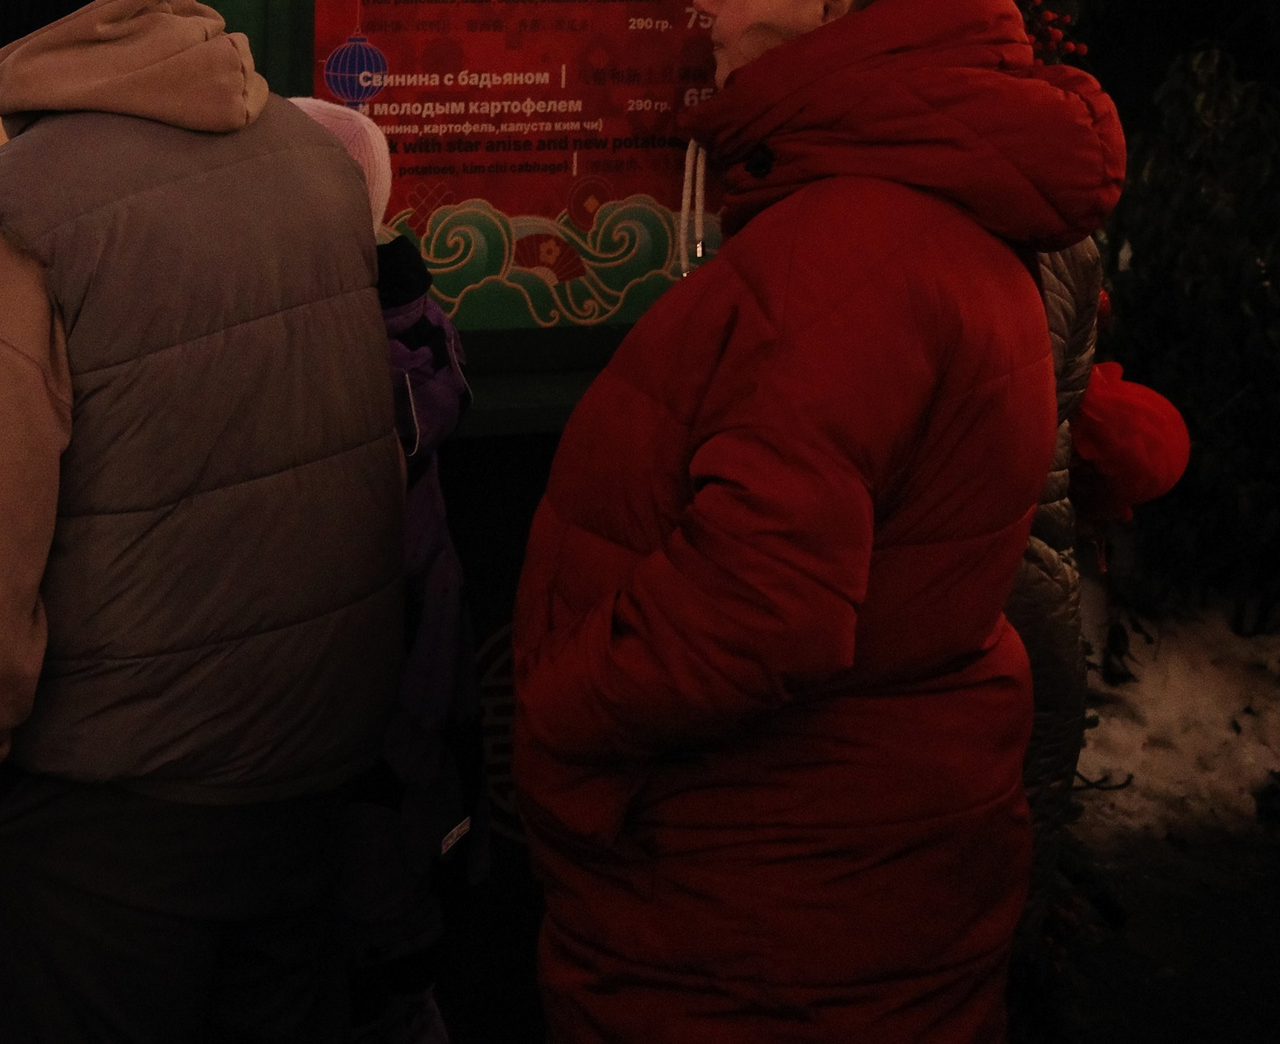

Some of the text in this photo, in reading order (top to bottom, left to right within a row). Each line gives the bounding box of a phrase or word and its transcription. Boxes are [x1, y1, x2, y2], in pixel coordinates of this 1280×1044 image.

[628, 17, 654, 30] 290
[684, 6, 715, 30] 75
[358, 69, 551, 89] Свинина с бадьяном
[373, 102, 465, 119] молодым
[469, 97, 583, 117] картофелем
[627, 99, 652, 112] 290
[554, 121, 581, 132] ким
[583, 117, 604, 132] чи)
[403, 137, 443, 154] with
[445, 138, 482, 153] star
[485, 137, 533, 152] anise
[536, 135, 569, 151] and
[573, 138, 609, 151] new
